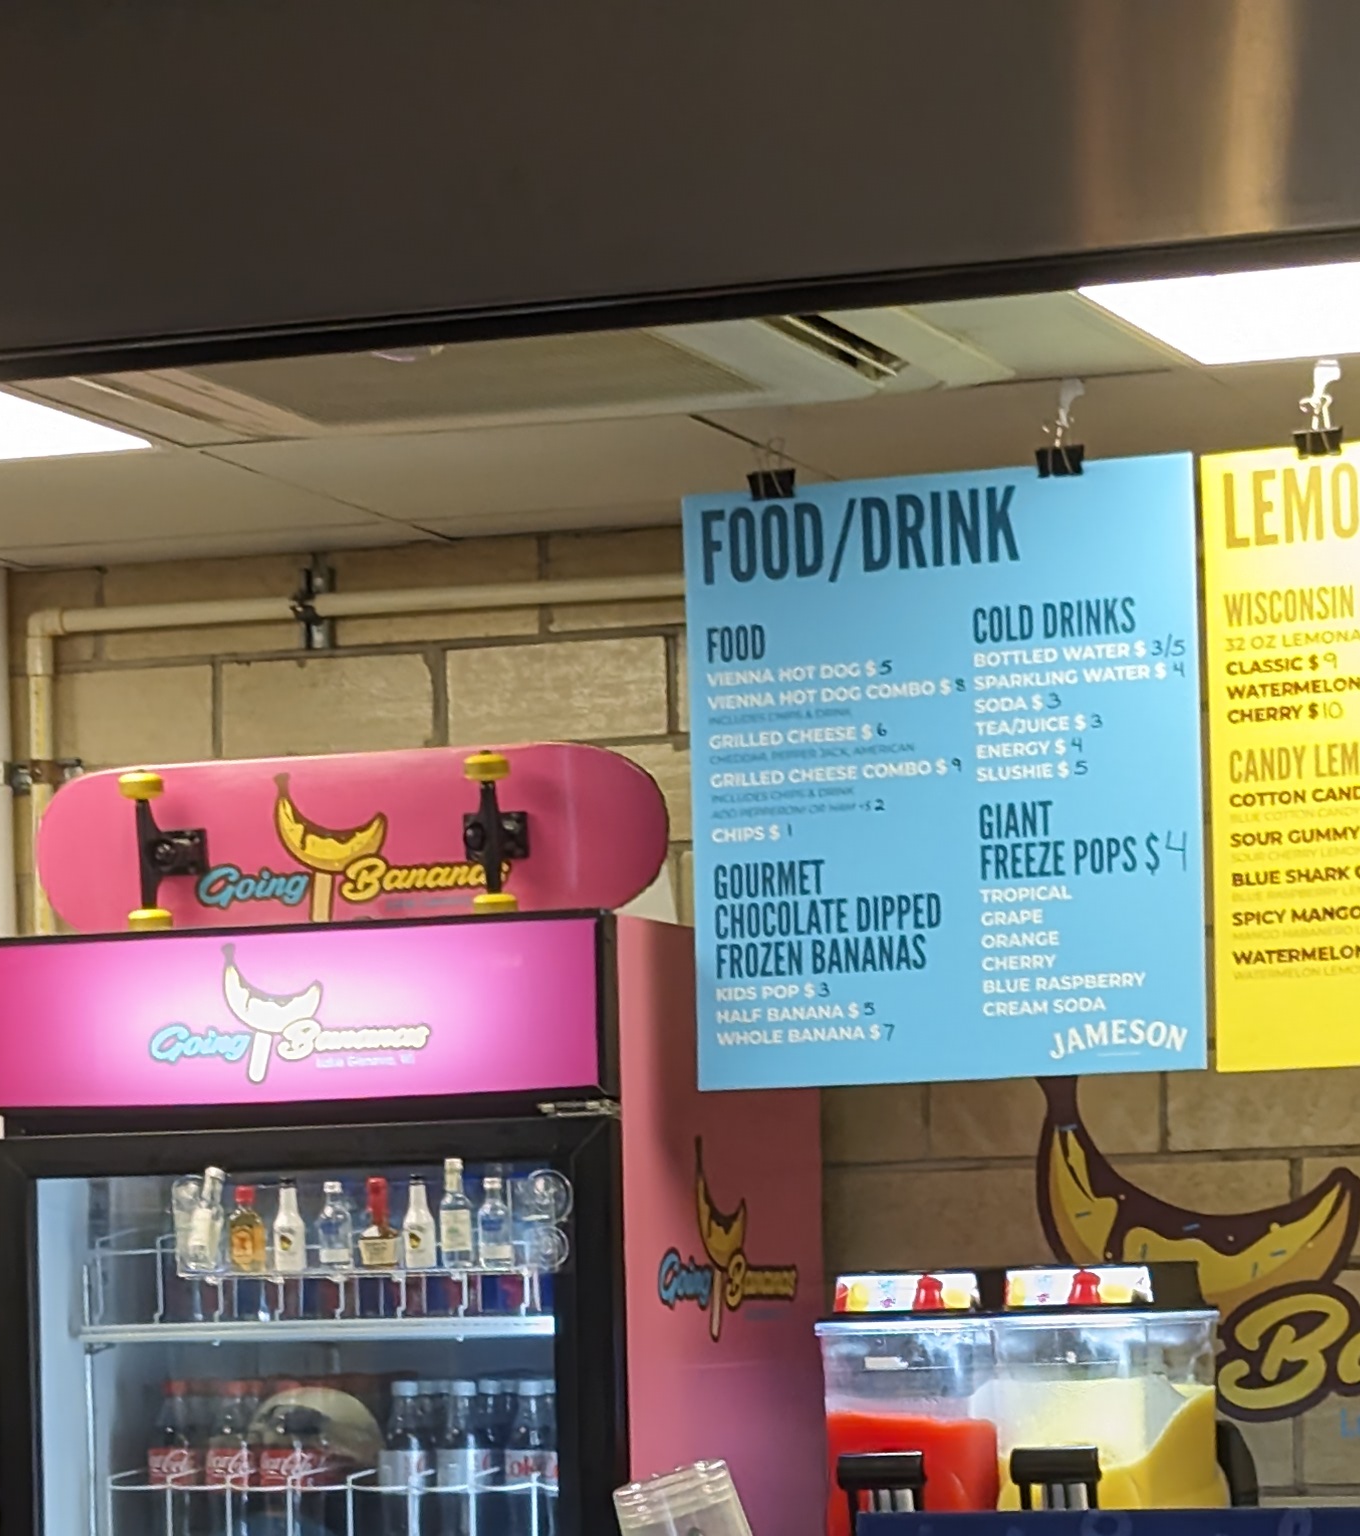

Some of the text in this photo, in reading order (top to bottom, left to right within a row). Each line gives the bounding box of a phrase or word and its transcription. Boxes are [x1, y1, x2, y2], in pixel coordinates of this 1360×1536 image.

[701, 485, 1020, 585] FOOD/DRINK
[1223, 585, 1354, 627] WISCONSIN
[973, 596, 1136, 644] COLD DRINKS
[707, 624, 765, 664] FOOD
[973, 642, 1130, 668] BOTTLED WATER
[1225, 636, 1247, 652] 32
[1250, 634, 1277, 650] OZ
[706, 661, 861, 687] VIENNA HOT DOG
[1226, 657, 1303, 675] CLASSIC
[974, 697, 1028, 714] SODA
[975, 716, 1070, 736] TEA/JUICE
[710, 760, 931, 788] GRILLED CHEESE COMBO
[976, 763, 1054, 782] SLUSHIE
[1229, 745, 1305, 785] CANDY
[1230, 790, 1306, 808] COTTON
[979, 801, 1052, 840] GIANT
[712, 826, 765, 843] CHIPS
[1230, 826, 1360, 848] SOUR GUMMY
[980, 836, 1136, 880] FREEZE POPS
[197, 863, 311, 907] Going
[714, 860, 824, 899] GOURMET
[980, 886, 1072, 904] TROPICAL
[715, 893, 941, 939] CHOCOLATE DIPPED
[981, 909, 1043, 926] GRAPE
[1233, 909, 1286, 927] SPICY
[981, 931, 1060, 949] ORANGE
[716, 934, 927, 979] FROZEN BANANAS
[982, 955, 1056, 972] CHERRY
[716, 983, 799, 1001] KIDS POP
[983, 972, 1146, 994] BLUE RASPBERRY
[716, 1004, 843, 1024] HALF BANANA
[150, 1024, 251, 1063] Going
[1050, 1019, 1187, 1060] JAMESON
